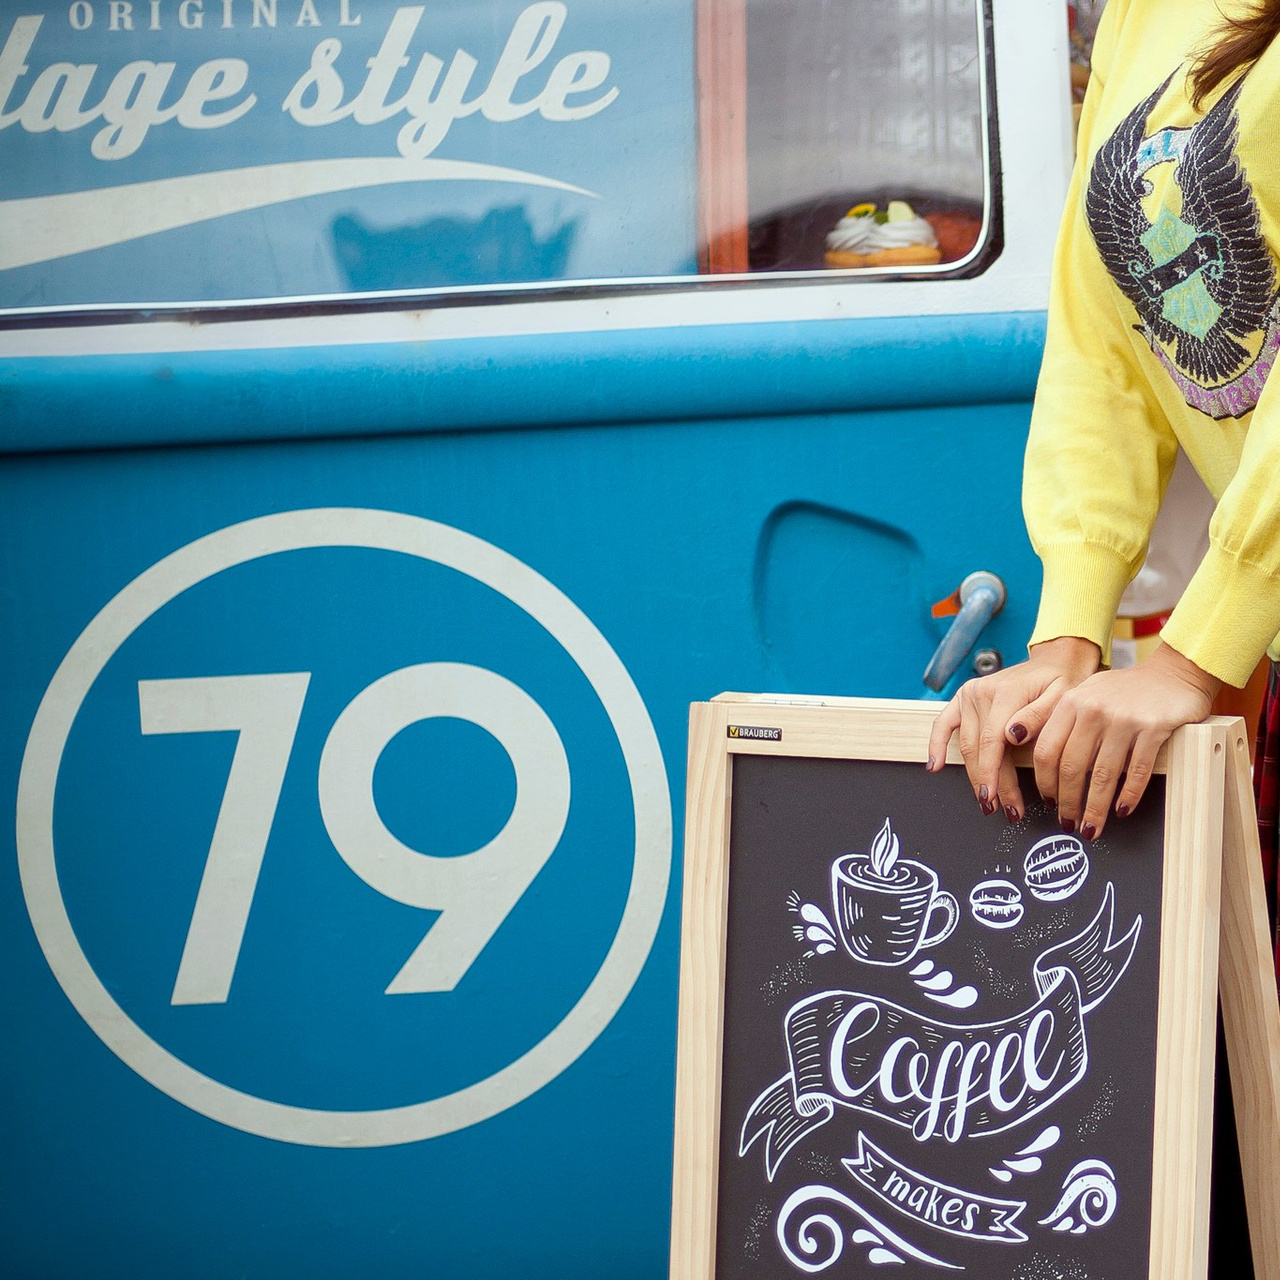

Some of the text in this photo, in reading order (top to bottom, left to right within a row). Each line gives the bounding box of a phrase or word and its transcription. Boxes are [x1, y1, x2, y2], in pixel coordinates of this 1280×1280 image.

[282, 1, 619, 160] style
[739, 727, 780, 739] BRAUBERG
[138, 661, 571, 1005] 79
[829, 1001, 1058, 1143] Coffee
[882, 1173, 980, 1231] makes
